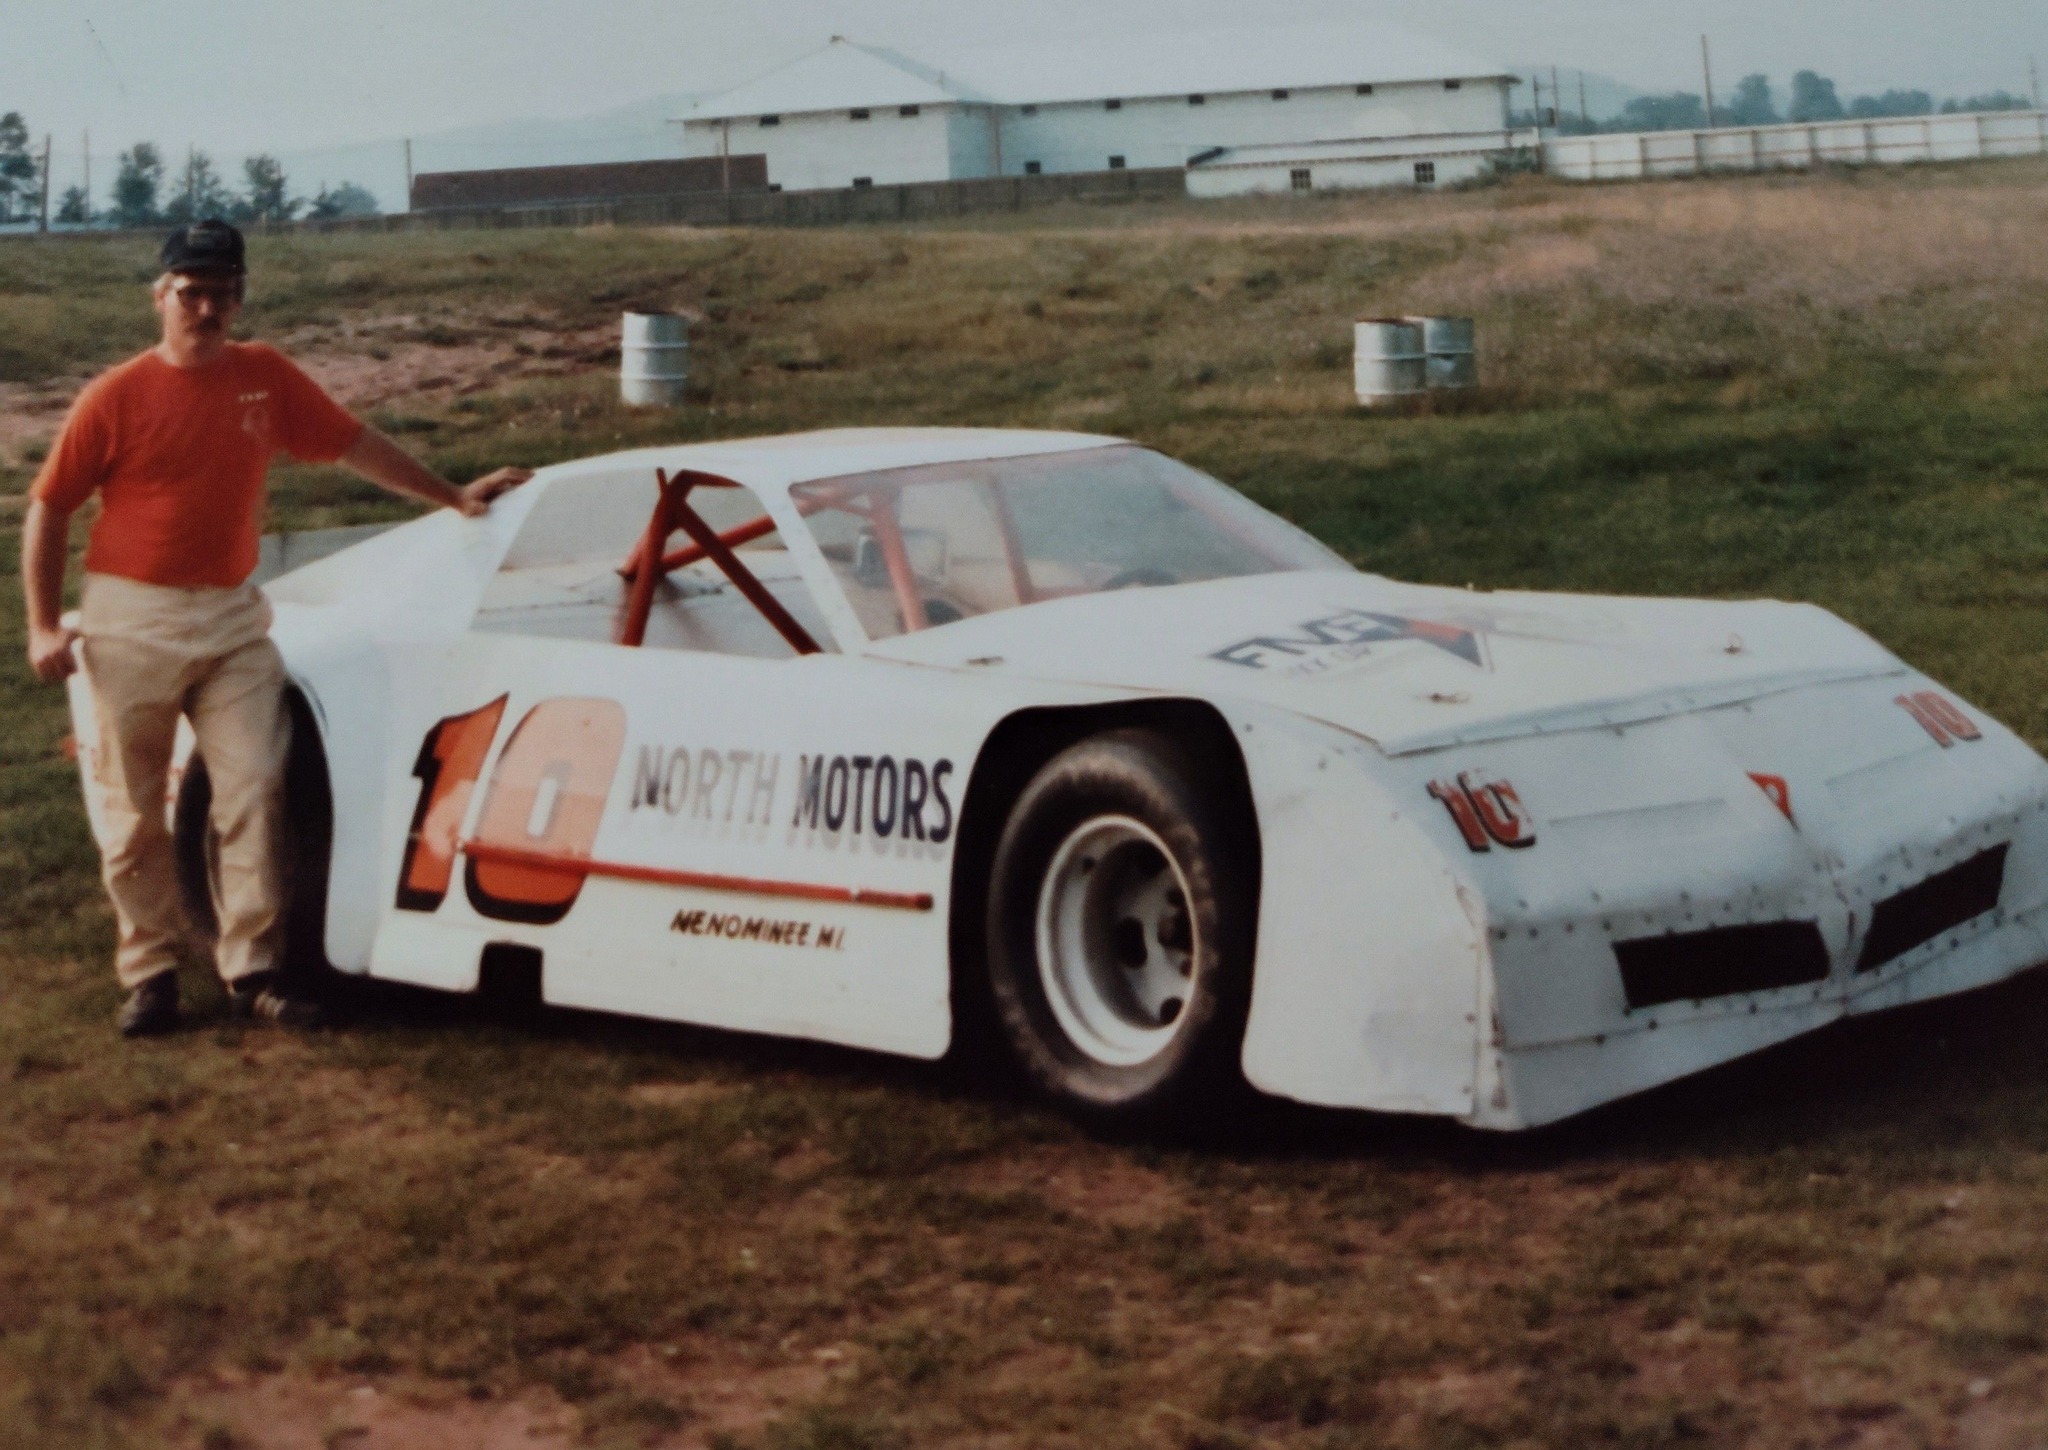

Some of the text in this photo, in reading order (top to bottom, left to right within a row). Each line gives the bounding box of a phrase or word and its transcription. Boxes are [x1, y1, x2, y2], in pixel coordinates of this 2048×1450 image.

[1892, 690, 1982, 748] 10
[395, 691, 628, 926] 10
[630, 744, 954, 843] NORTH MOTORS
[1426, 767, 1538, 852] 10
[670, 909, 811, 947] MENOMINEE
